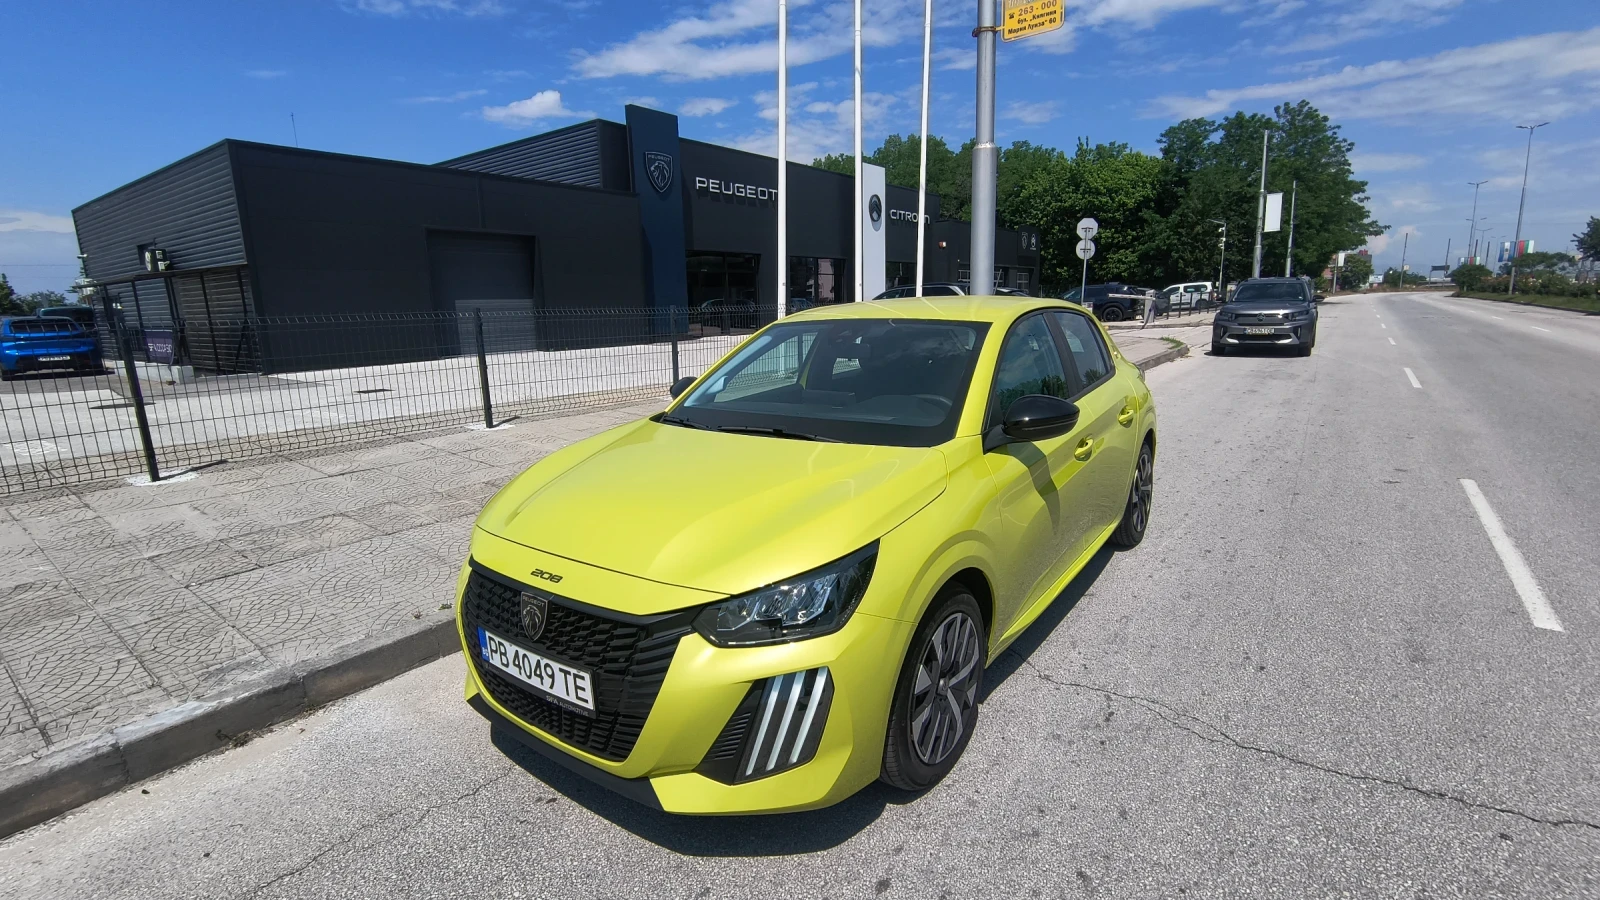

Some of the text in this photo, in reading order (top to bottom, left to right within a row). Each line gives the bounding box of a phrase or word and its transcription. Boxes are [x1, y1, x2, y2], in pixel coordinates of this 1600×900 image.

[695, 176, 778, 201] PEUGEOT
[889, 209, 930, 225] CITROn
[530, 568, 564, 584] 208
[522, 595, 545, 608] PEUGEOT
[487, 635, 589, 704] PB 4049 TE
